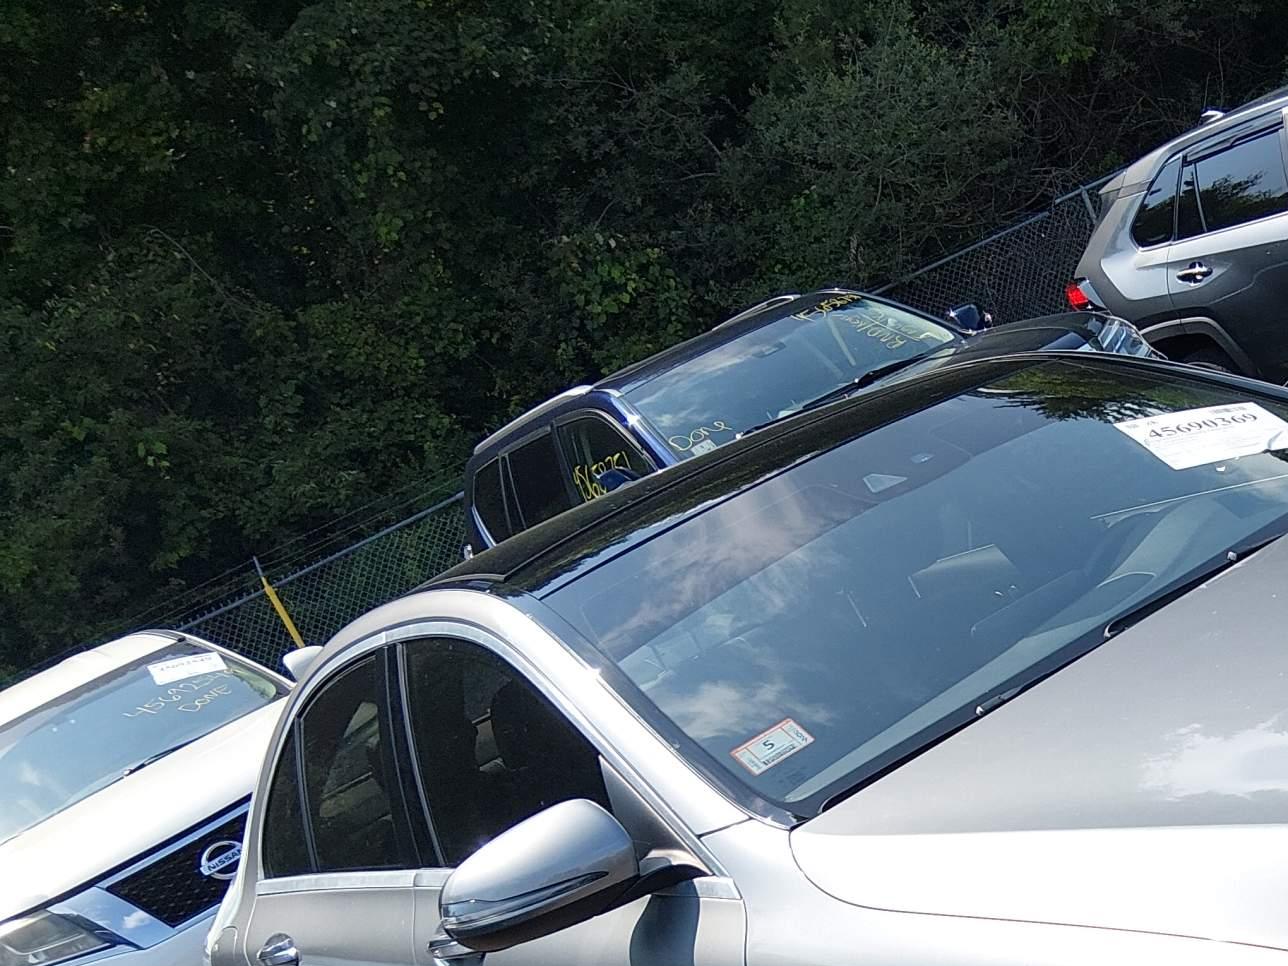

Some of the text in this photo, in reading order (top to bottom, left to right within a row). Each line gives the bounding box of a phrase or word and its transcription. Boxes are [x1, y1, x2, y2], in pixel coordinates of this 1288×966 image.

[668, 421, 732, 451] Done
[1149, 412, 1258, 439] 45690369
[178, 684, 232, 712] DONE
[763, 740, 775, 750] 5
